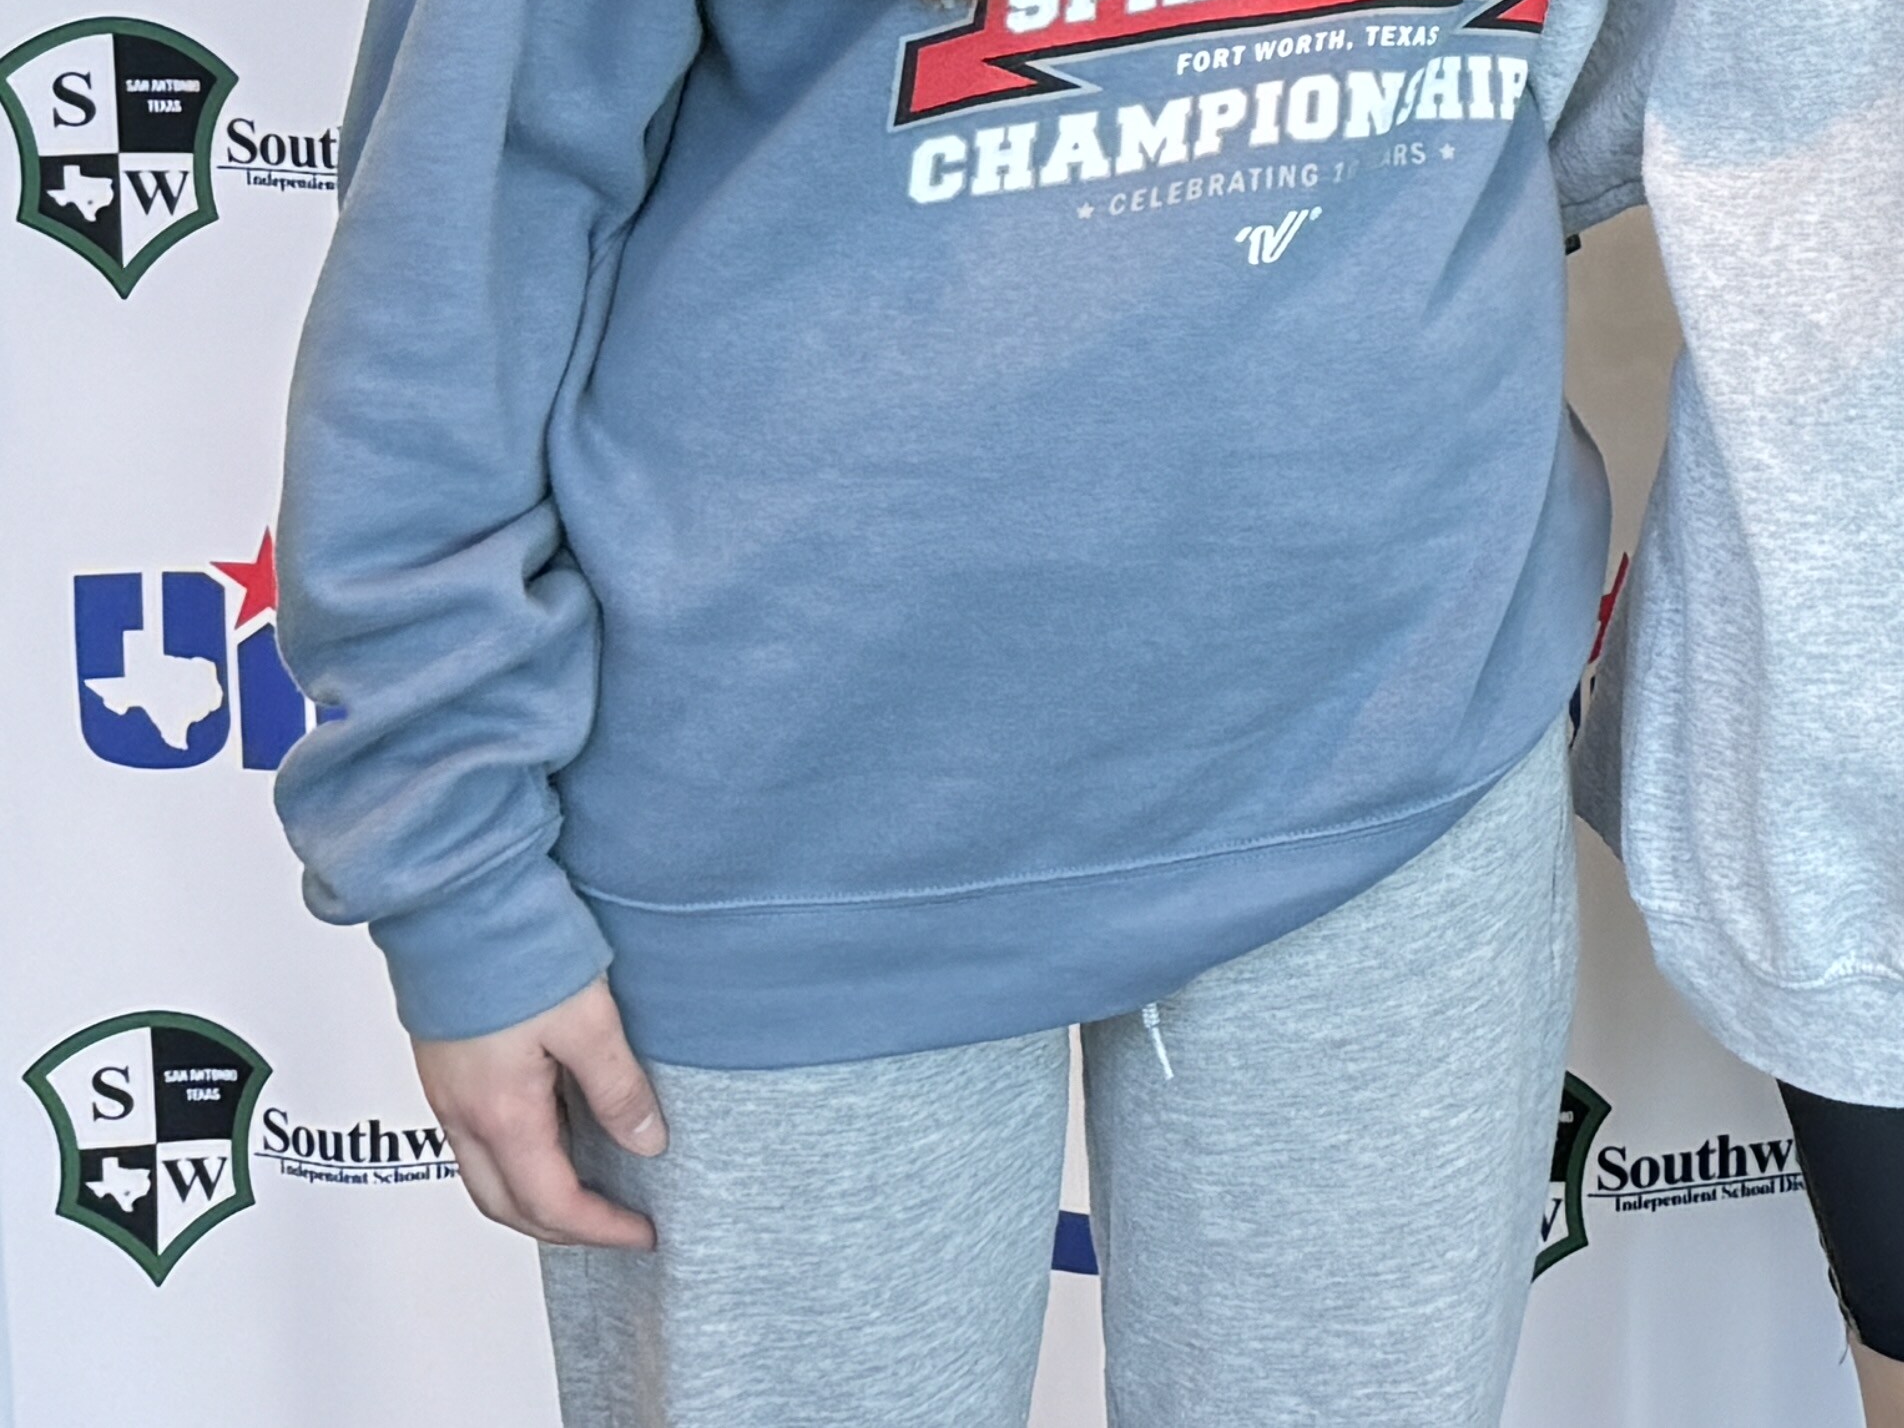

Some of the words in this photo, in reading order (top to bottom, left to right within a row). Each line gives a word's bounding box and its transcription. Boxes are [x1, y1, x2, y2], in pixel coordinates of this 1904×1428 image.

[1176, 45, 1247, 75] FORT
[1254, 29, 1354, 63] WORTH,
[1366, 25, 1440, 47] TEXAS
[52, 72, 99, 128] S
[124, 170, 189, 216] W
[1108, 162, 1319, 218] CELEBRATING
[92, 1064, 132, 1122] S
[262, 1107, 446, 1164] Southw
[1597, 1134, 1794, 1192] Southw
[160, 1159, 226, 1202] W
